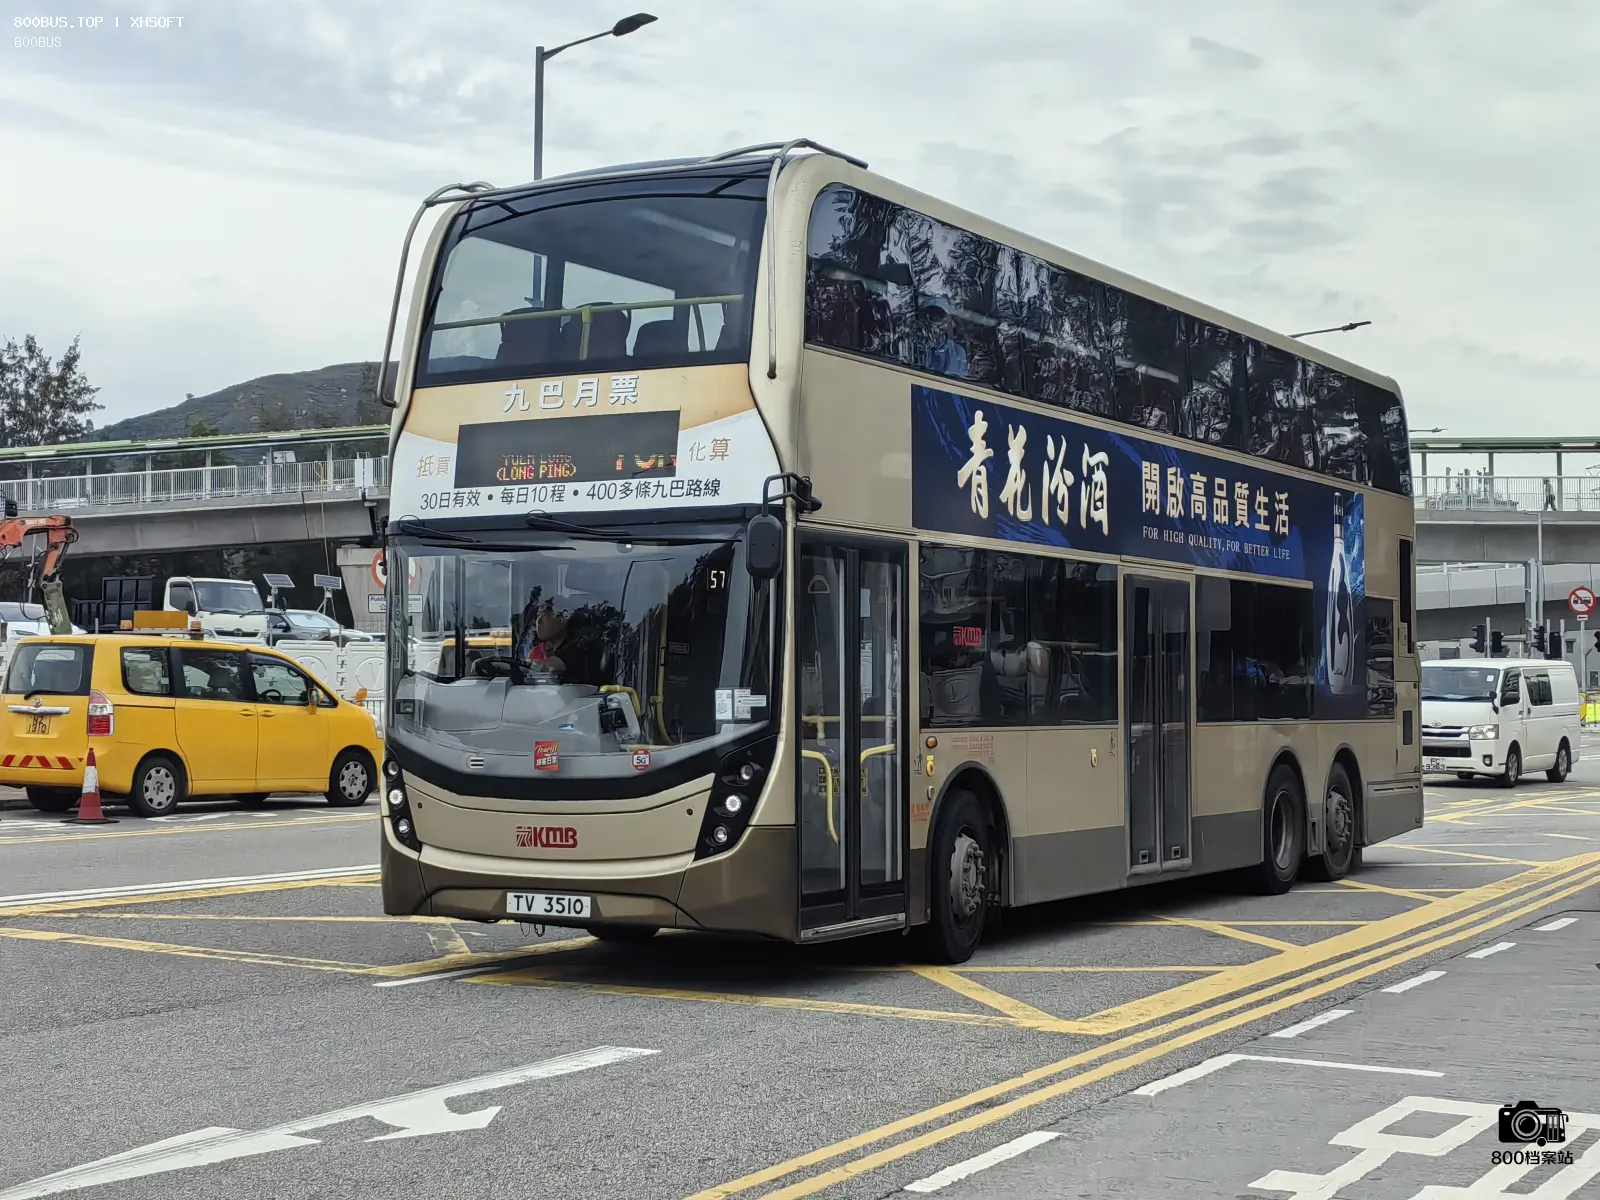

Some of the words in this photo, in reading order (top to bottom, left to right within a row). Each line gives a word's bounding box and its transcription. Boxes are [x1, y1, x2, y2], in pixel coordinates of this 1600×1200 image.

[503, 374, 640, 413] 九巴月票
[688, 437, 731, 462] 化算
[586, 477, 721, 500] 400多條九巴路線
[957, 410, 1109, 537] 青花汾酒
[1142, 460, 1290, 536] 開啟高品質生活
[1142, 525, 1159, 540] FOR
[1163, 529, 1184, 544] HIGH
[1244, 542, 1270, 557] BETTER
[1273, 547, 1291, 560] LIFE
[532, 826, 578, 849] KMB
[513, 894, 535, 912] TV
[543, 896, 584, 915] 3510
